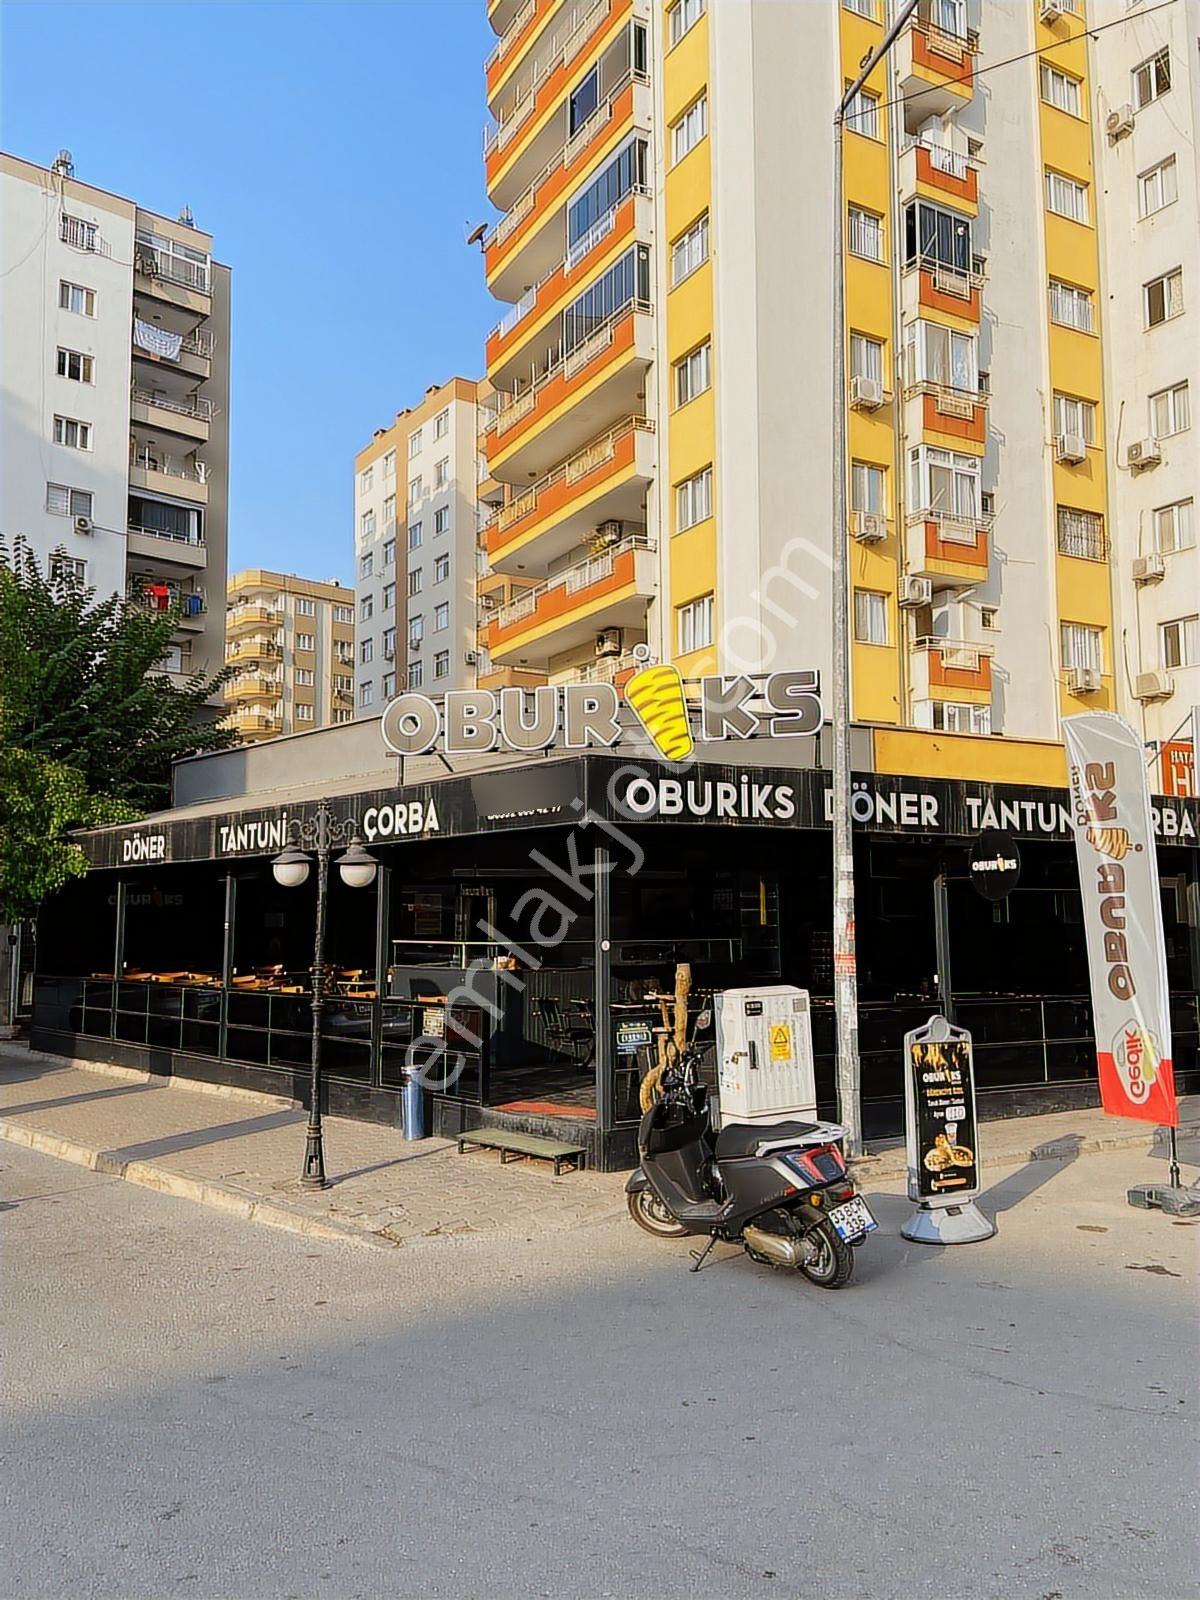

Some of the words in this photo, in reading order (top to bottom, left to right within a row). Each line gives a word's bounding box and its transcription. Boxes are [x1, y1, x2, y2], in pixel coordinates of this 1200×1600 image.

[123, 832, 165, 863] DÖNER
[220, 811, 287, 852] TANTUNİ
[363, 798, 440, 842] ÇORBA
